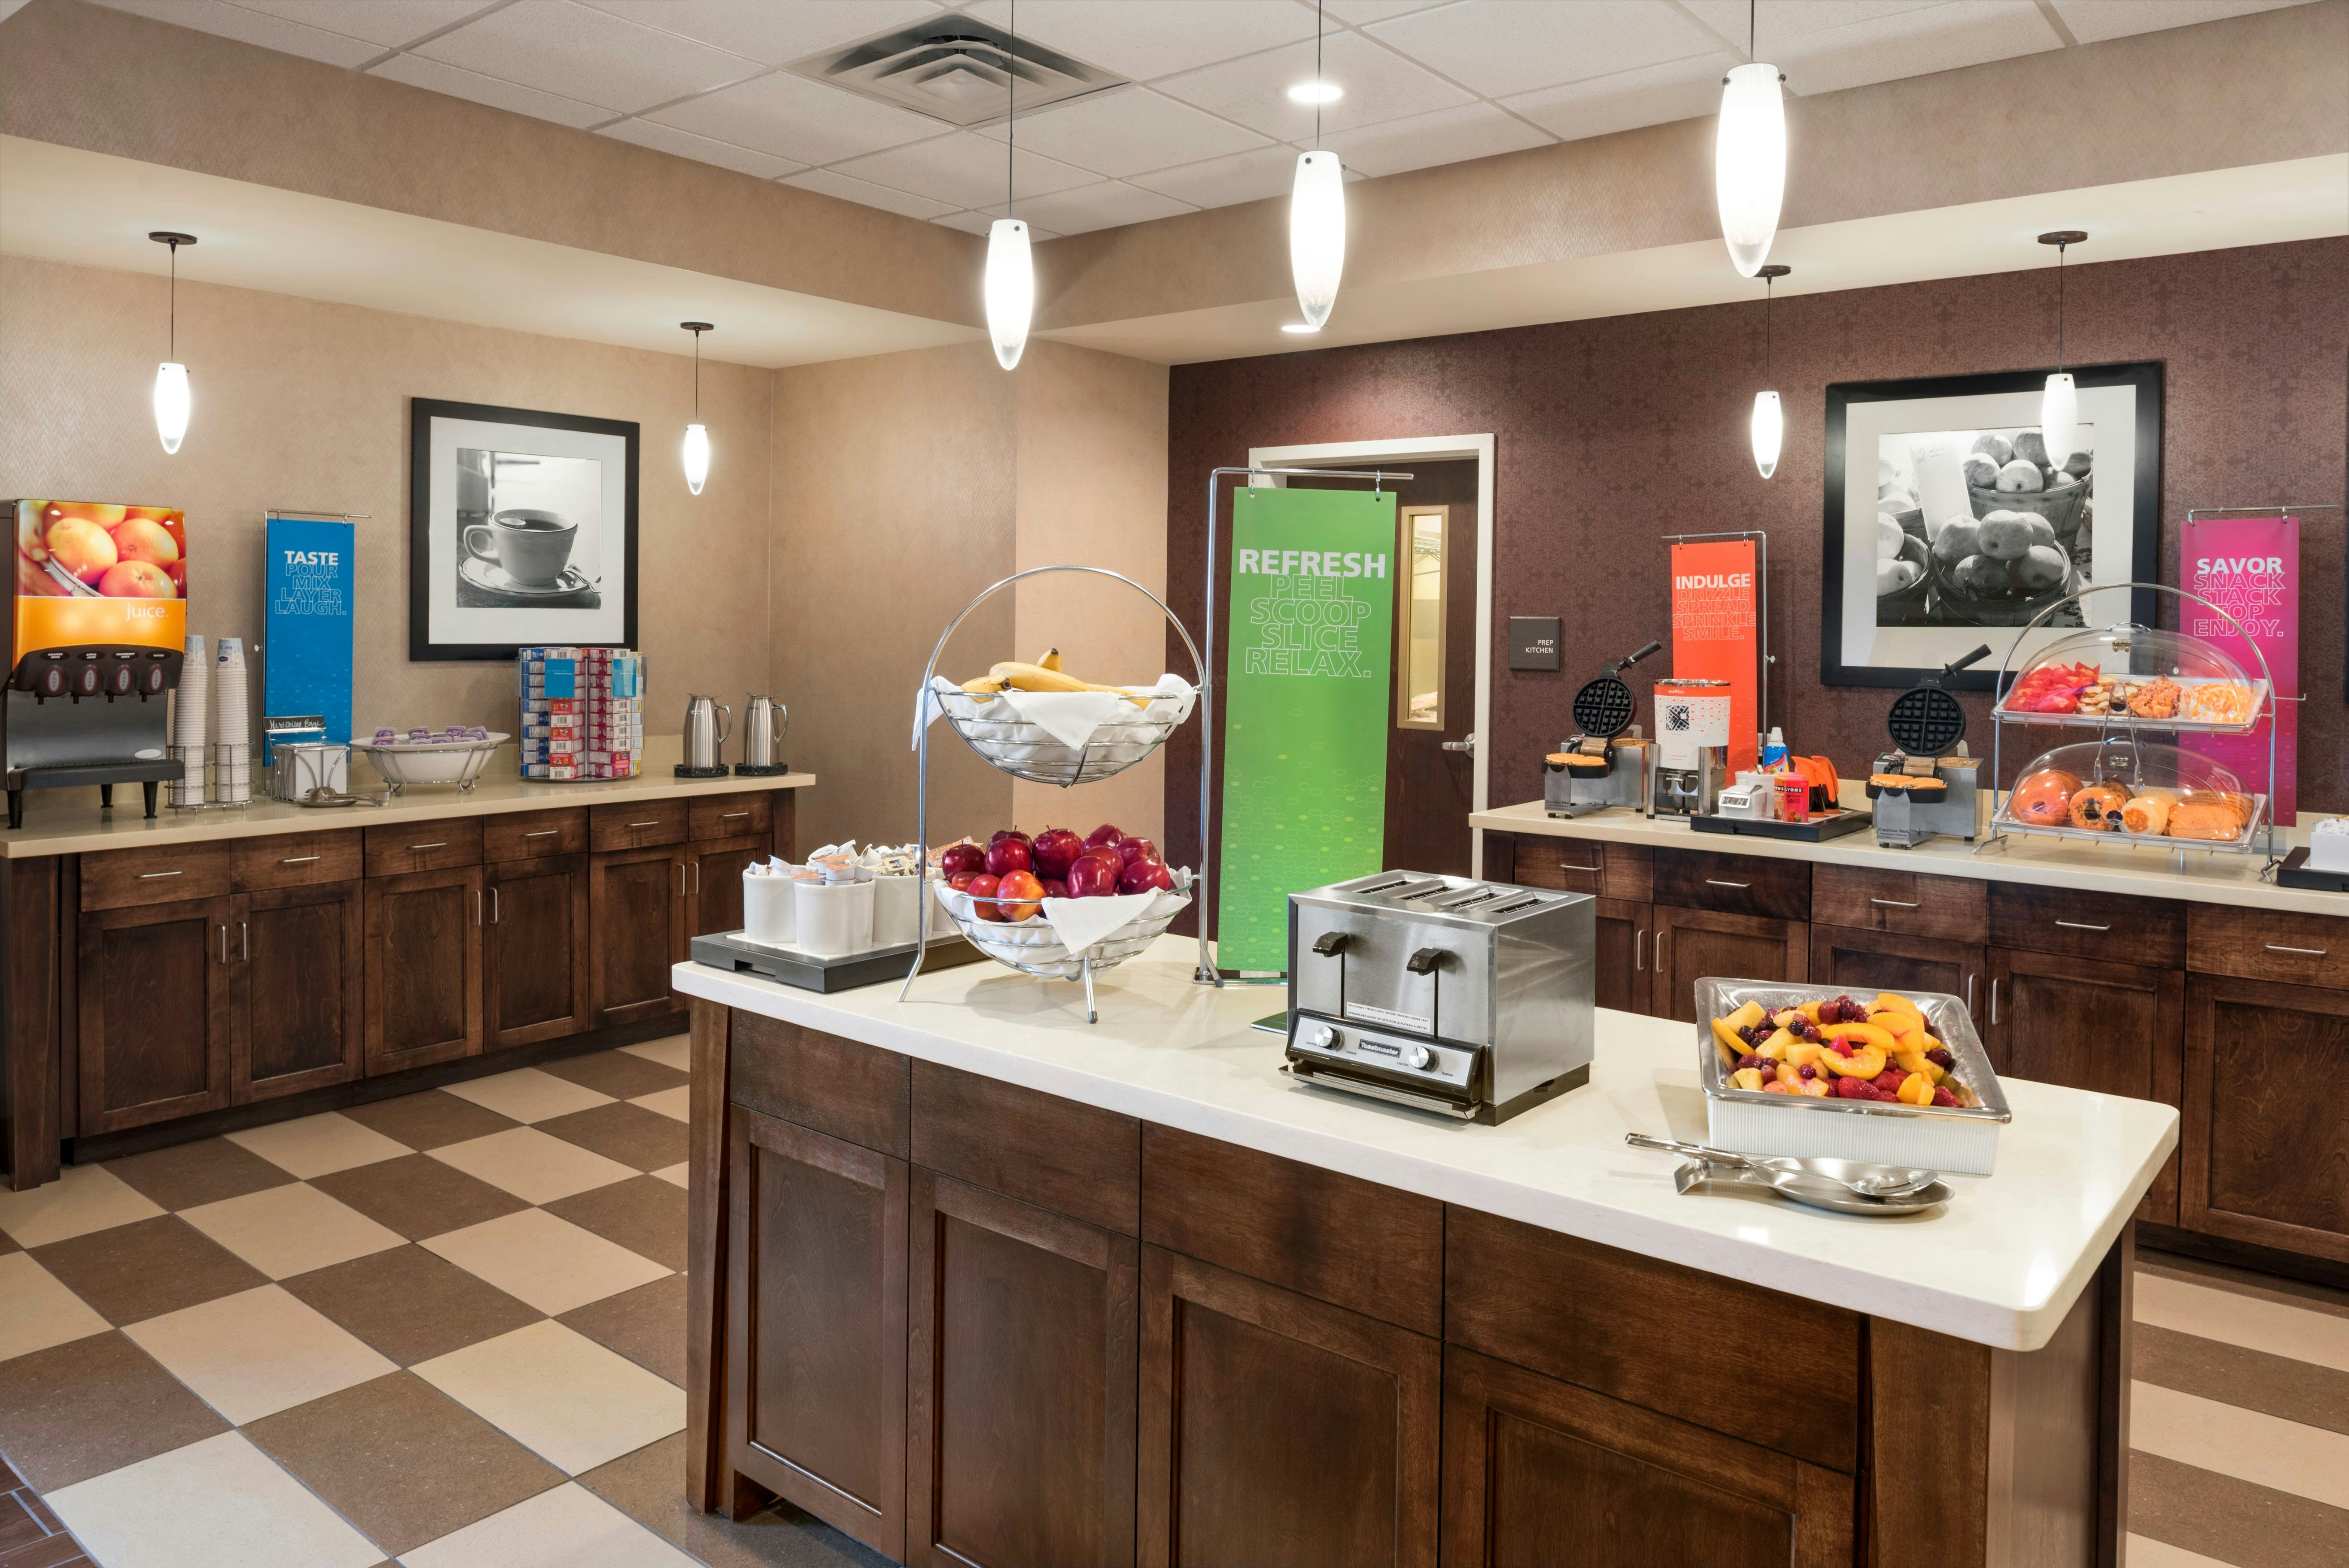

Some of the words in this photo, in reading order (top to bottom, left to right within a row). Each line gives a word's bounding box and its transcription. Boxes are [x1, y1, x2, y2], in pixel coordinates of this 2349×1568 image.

[284, 551, 339, 565] TASTE
[1239, 549, 1386, 578] REFRESH
[2197, 557, 2282, 574] SAVOR
[285, 563, 337, 577] POUR
[293, 576, 331, 590] MIX
[1270, 574, 1353, 601] PEEL
[1676, 573, 1751, 589] INDULGE
[2194, 572, 2285, 590] SNACK
[281, 588, 342, 603] LAYER
[1677, 586, 1750, 602] DRIZZLE
[2197, 588, 2281, 605] STACK
[125, 603, 169, 621] juice.
[275, 600, 347, 615] LAUGH.
[1250, 597, 1371, 627] SCOOP
[1677, 599, 1750, 615] SPREAD
[2216, 603, 2264, 620] TOP
[1672, 612, 1756, 628] SPRINKLE
[2194, 619, 2284, 637] ENJOY.
[1262, 624, 1358, 652] SLICE
[1683, 626, 1745, 641] SMILE.
[1245, 647, 1371, 677] RELAX.
[1361, 1042, 1399, 1055] Toastmaster
